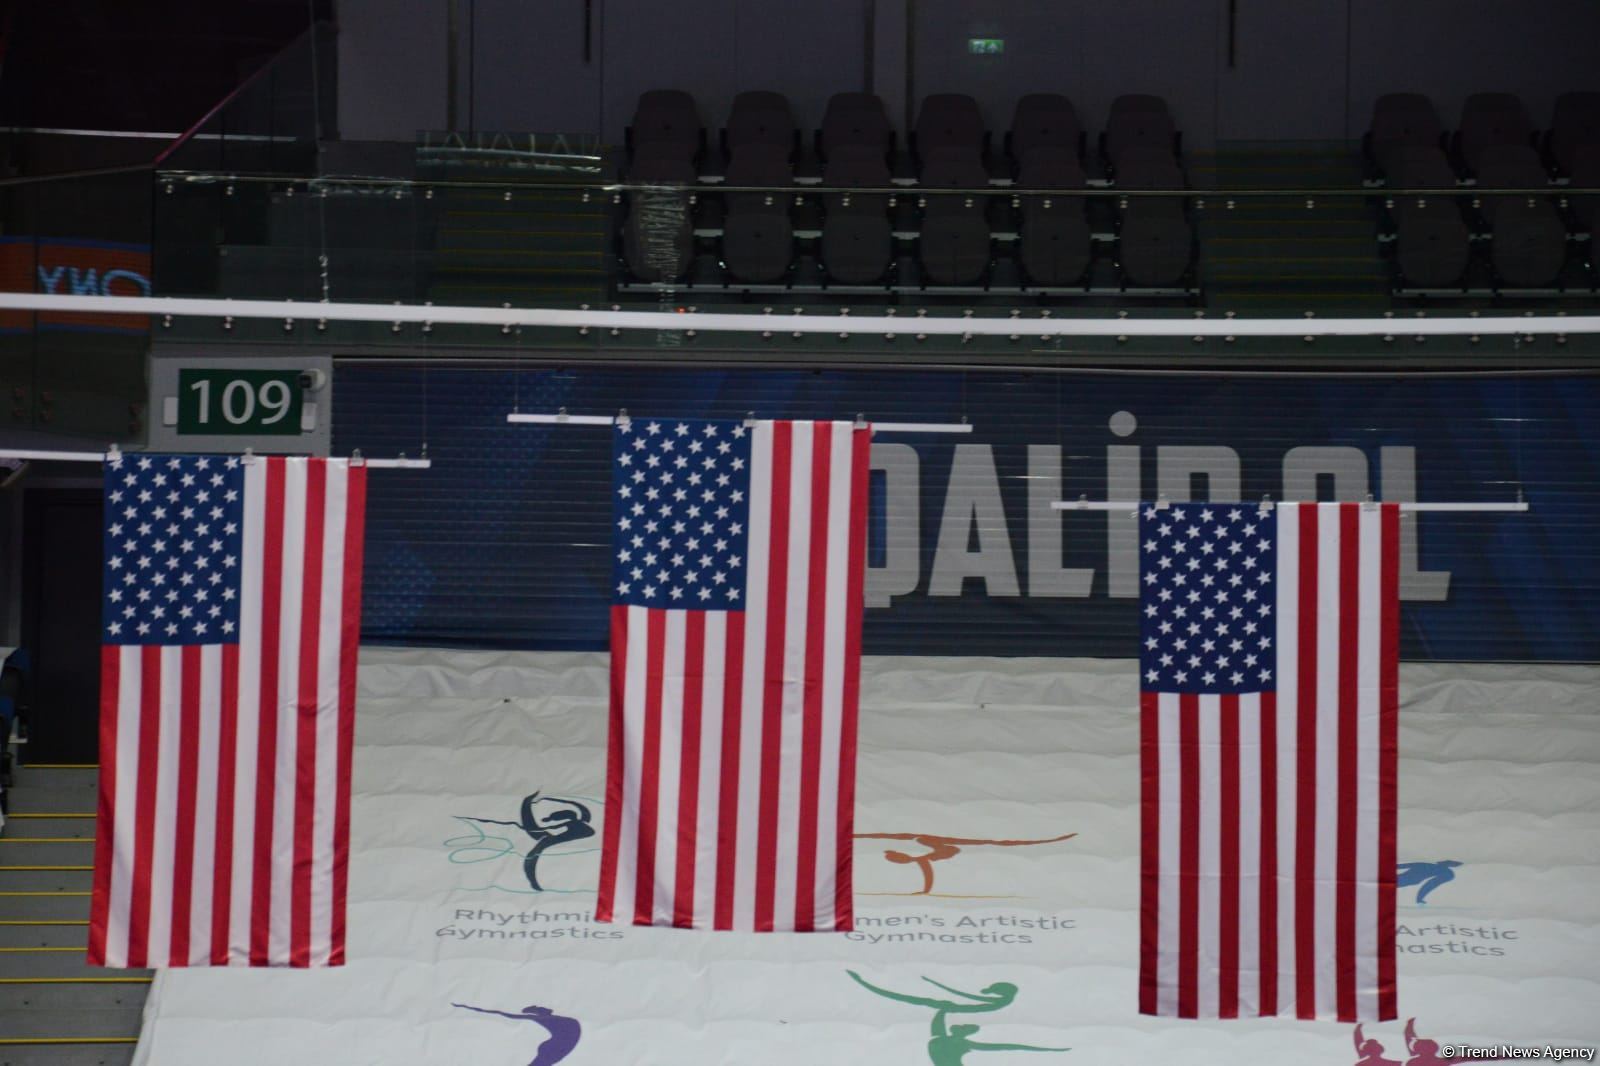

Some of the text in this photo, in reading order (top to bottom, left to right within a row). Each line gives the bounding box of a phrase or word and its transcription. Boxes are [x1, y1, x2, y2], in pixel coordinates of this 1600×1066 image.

[190, 379, 291, 425] 109
[455, 909, 600, 926] Rhythmi
[855, 914, 1077, 930] men's Artistic
[435, 924, 625, 940] Gymnastics
[845, 930, 1033, 944] Gymnastics
[1396, 924, 1519, 940] Artistic
[1396, 941, 1505, 957] astics
